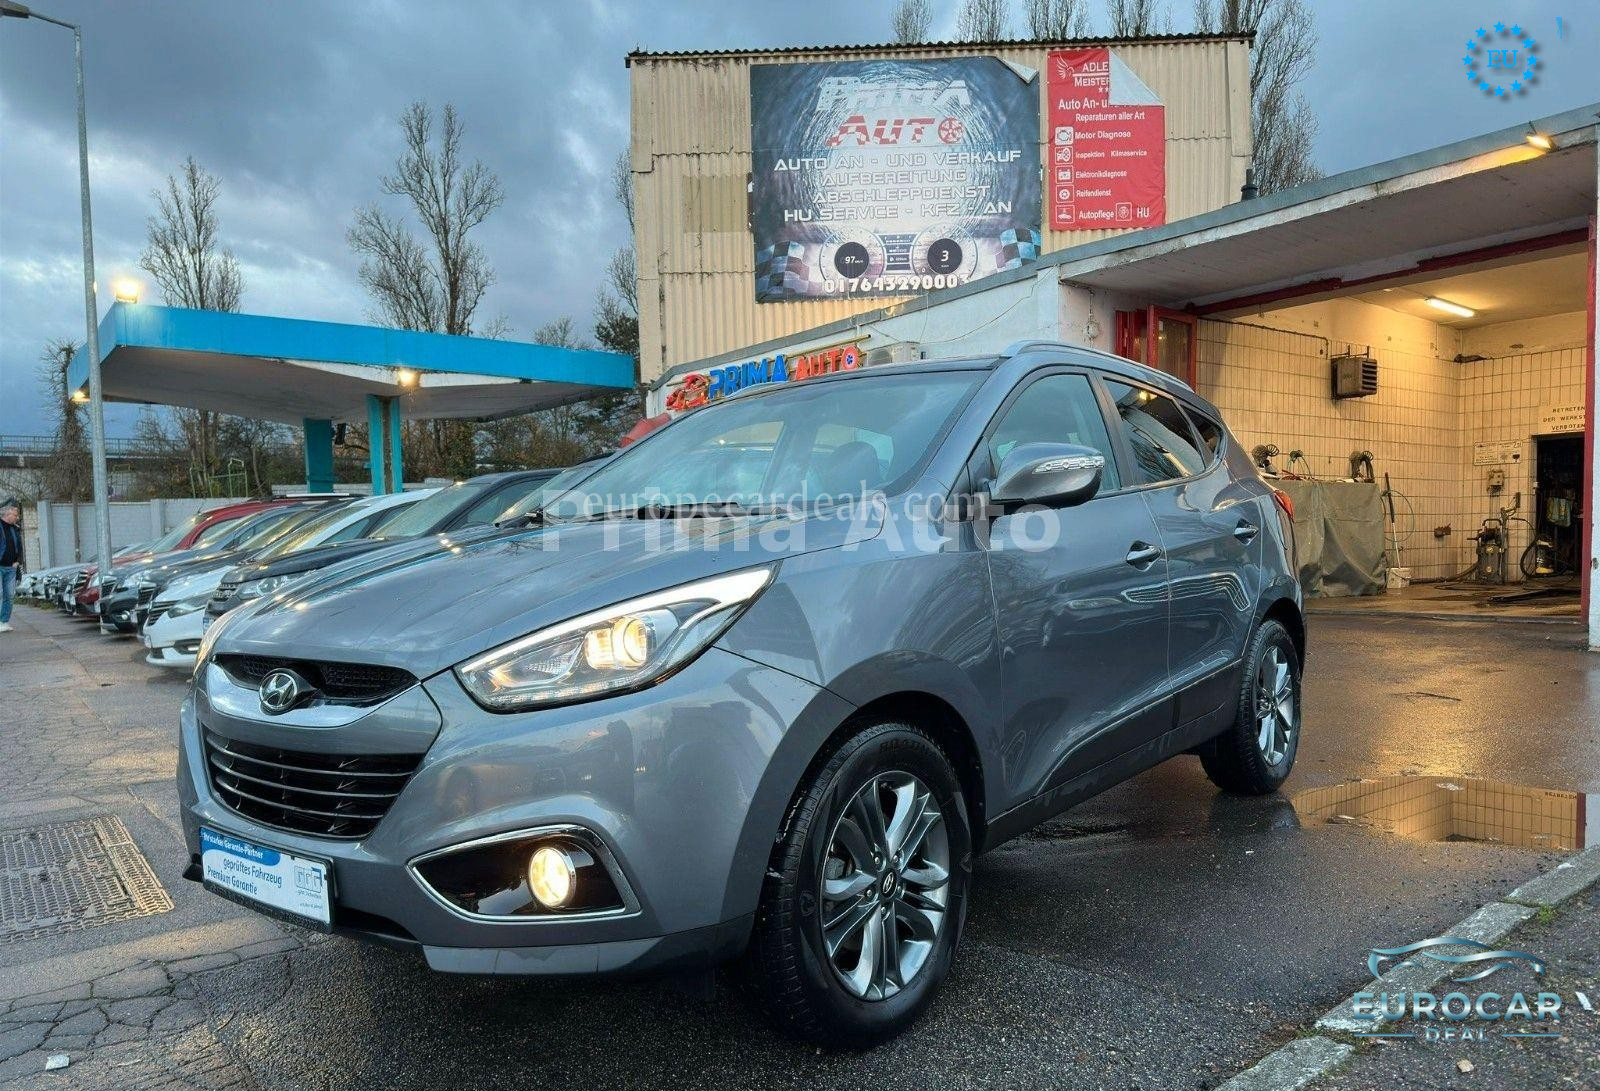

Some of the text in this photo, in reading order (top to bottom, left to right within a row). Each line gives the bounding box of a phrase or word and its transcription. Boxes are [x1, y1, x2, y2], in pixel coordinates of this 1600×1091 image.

[1058, 98, 1081, 110] Auto
[1083, 97, 1099, 109] An-
[1075, 111, 1145, 123] Reparaturen aller Art
[1074, 130, 1131, 140] Motor Diagnose
[774, 157, 828, 171] AUTO
[835, 156, 863, 169] AN
[887, 153, 927, 168] UND
[934, 150, 1022, 165] VERKAUF
[1075, 149, 1148, 159] Inspektion Klimaservice
[822, 169, 967, 187] AUFBEREITUNG
[1075, 170, 1128, 179] Elektronikdiagnose
[812, 185, 991, 204] ABSCHLEPPDIENST
[1076, 189, 1112, 197] Reifendienst
[784, 208, 812, 222] HU
[819, 205, 899, 221] SERVICE
[921, 203, 961, 217] KFZ
[983, 200, 1012, 214] AN
[1078, 206, 1150, 220] Autopflege HU
[845, 255, 856, 264] 97
[940, 250, 949, 262] 3
[708, 345, 860, 400] PRIMA AUTO
[207, 865, 258, 895] Premium Garantie
[223, 858, 251, 876] geprüftes
[251, 865, 283, 889] Fahrzeug
